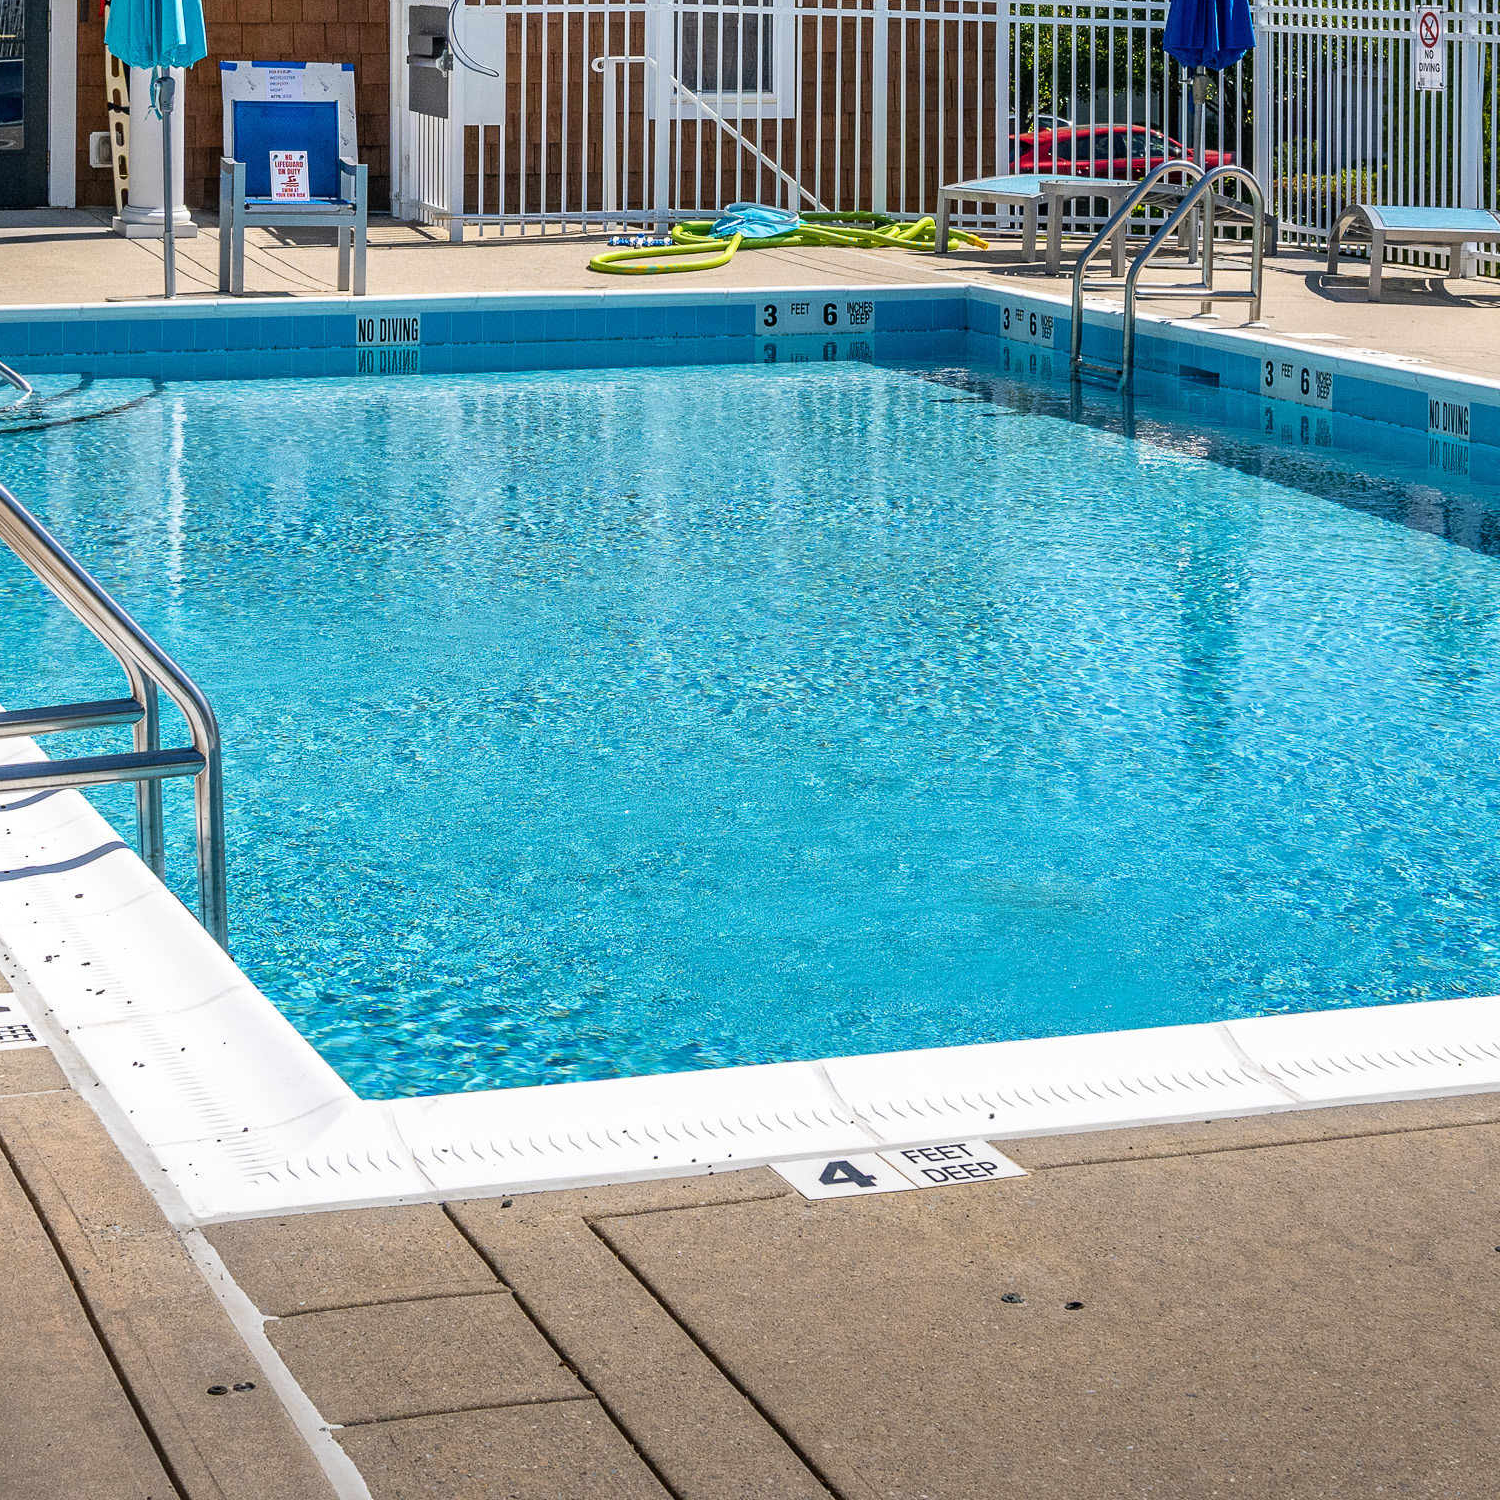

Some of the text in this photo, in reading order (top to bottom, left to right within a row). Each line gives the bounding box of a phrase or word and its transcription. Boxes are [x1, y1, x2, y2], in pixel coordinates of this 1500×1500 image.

[1425, 50, 1434, 59] NO
[1419, 62, 1440, 73] DIVING
[764, 302, 873, 327] 3 FEET 6 INCHES
[850, 313, 870, 325] DEEP
[1004, 307, 1010, 330] 3
[1016, 309, 1024, 321] FEET
[1030, 312, 1036, 336] 6
[359, 318, 418, 342] NO DIVING
[1265, 361, 1332, 395] 3 FEET 6 INCHES
[1317, 384, 1330, 399] DEEP
[1430, 399, 1468, 435] NO DIVING
[818, 1143, 974, 1188] 4 FEET
[921, 1161, 998, 1183] DEEP
